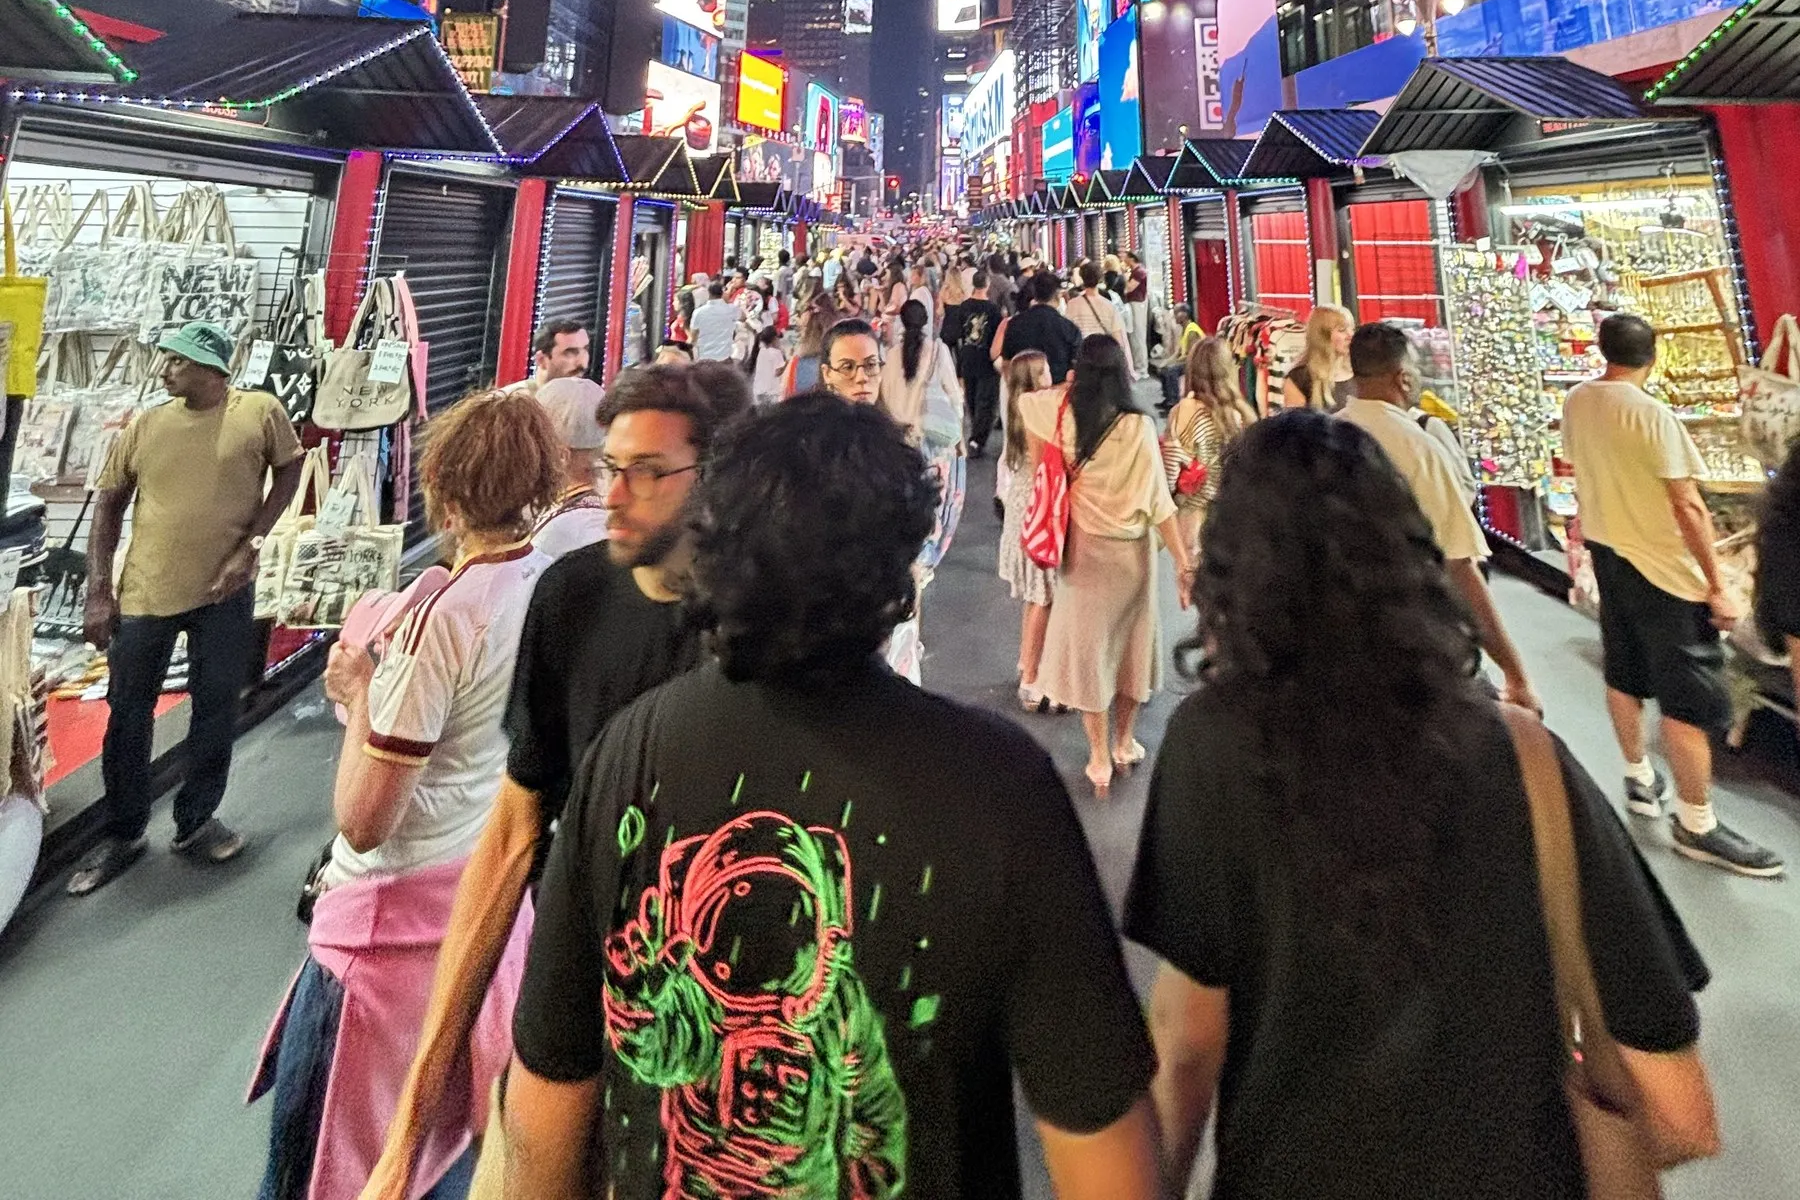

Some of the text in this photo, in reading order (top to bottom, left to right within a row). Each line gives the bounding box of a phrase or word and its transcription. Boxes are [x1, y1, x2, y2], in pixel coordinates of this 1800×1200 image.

[159, 264, 253, 294] NEW
[160, 294, 253, 321] YORK
[342, 384, 390, 396] NEW
[335, 395, 394, 409] YORK
